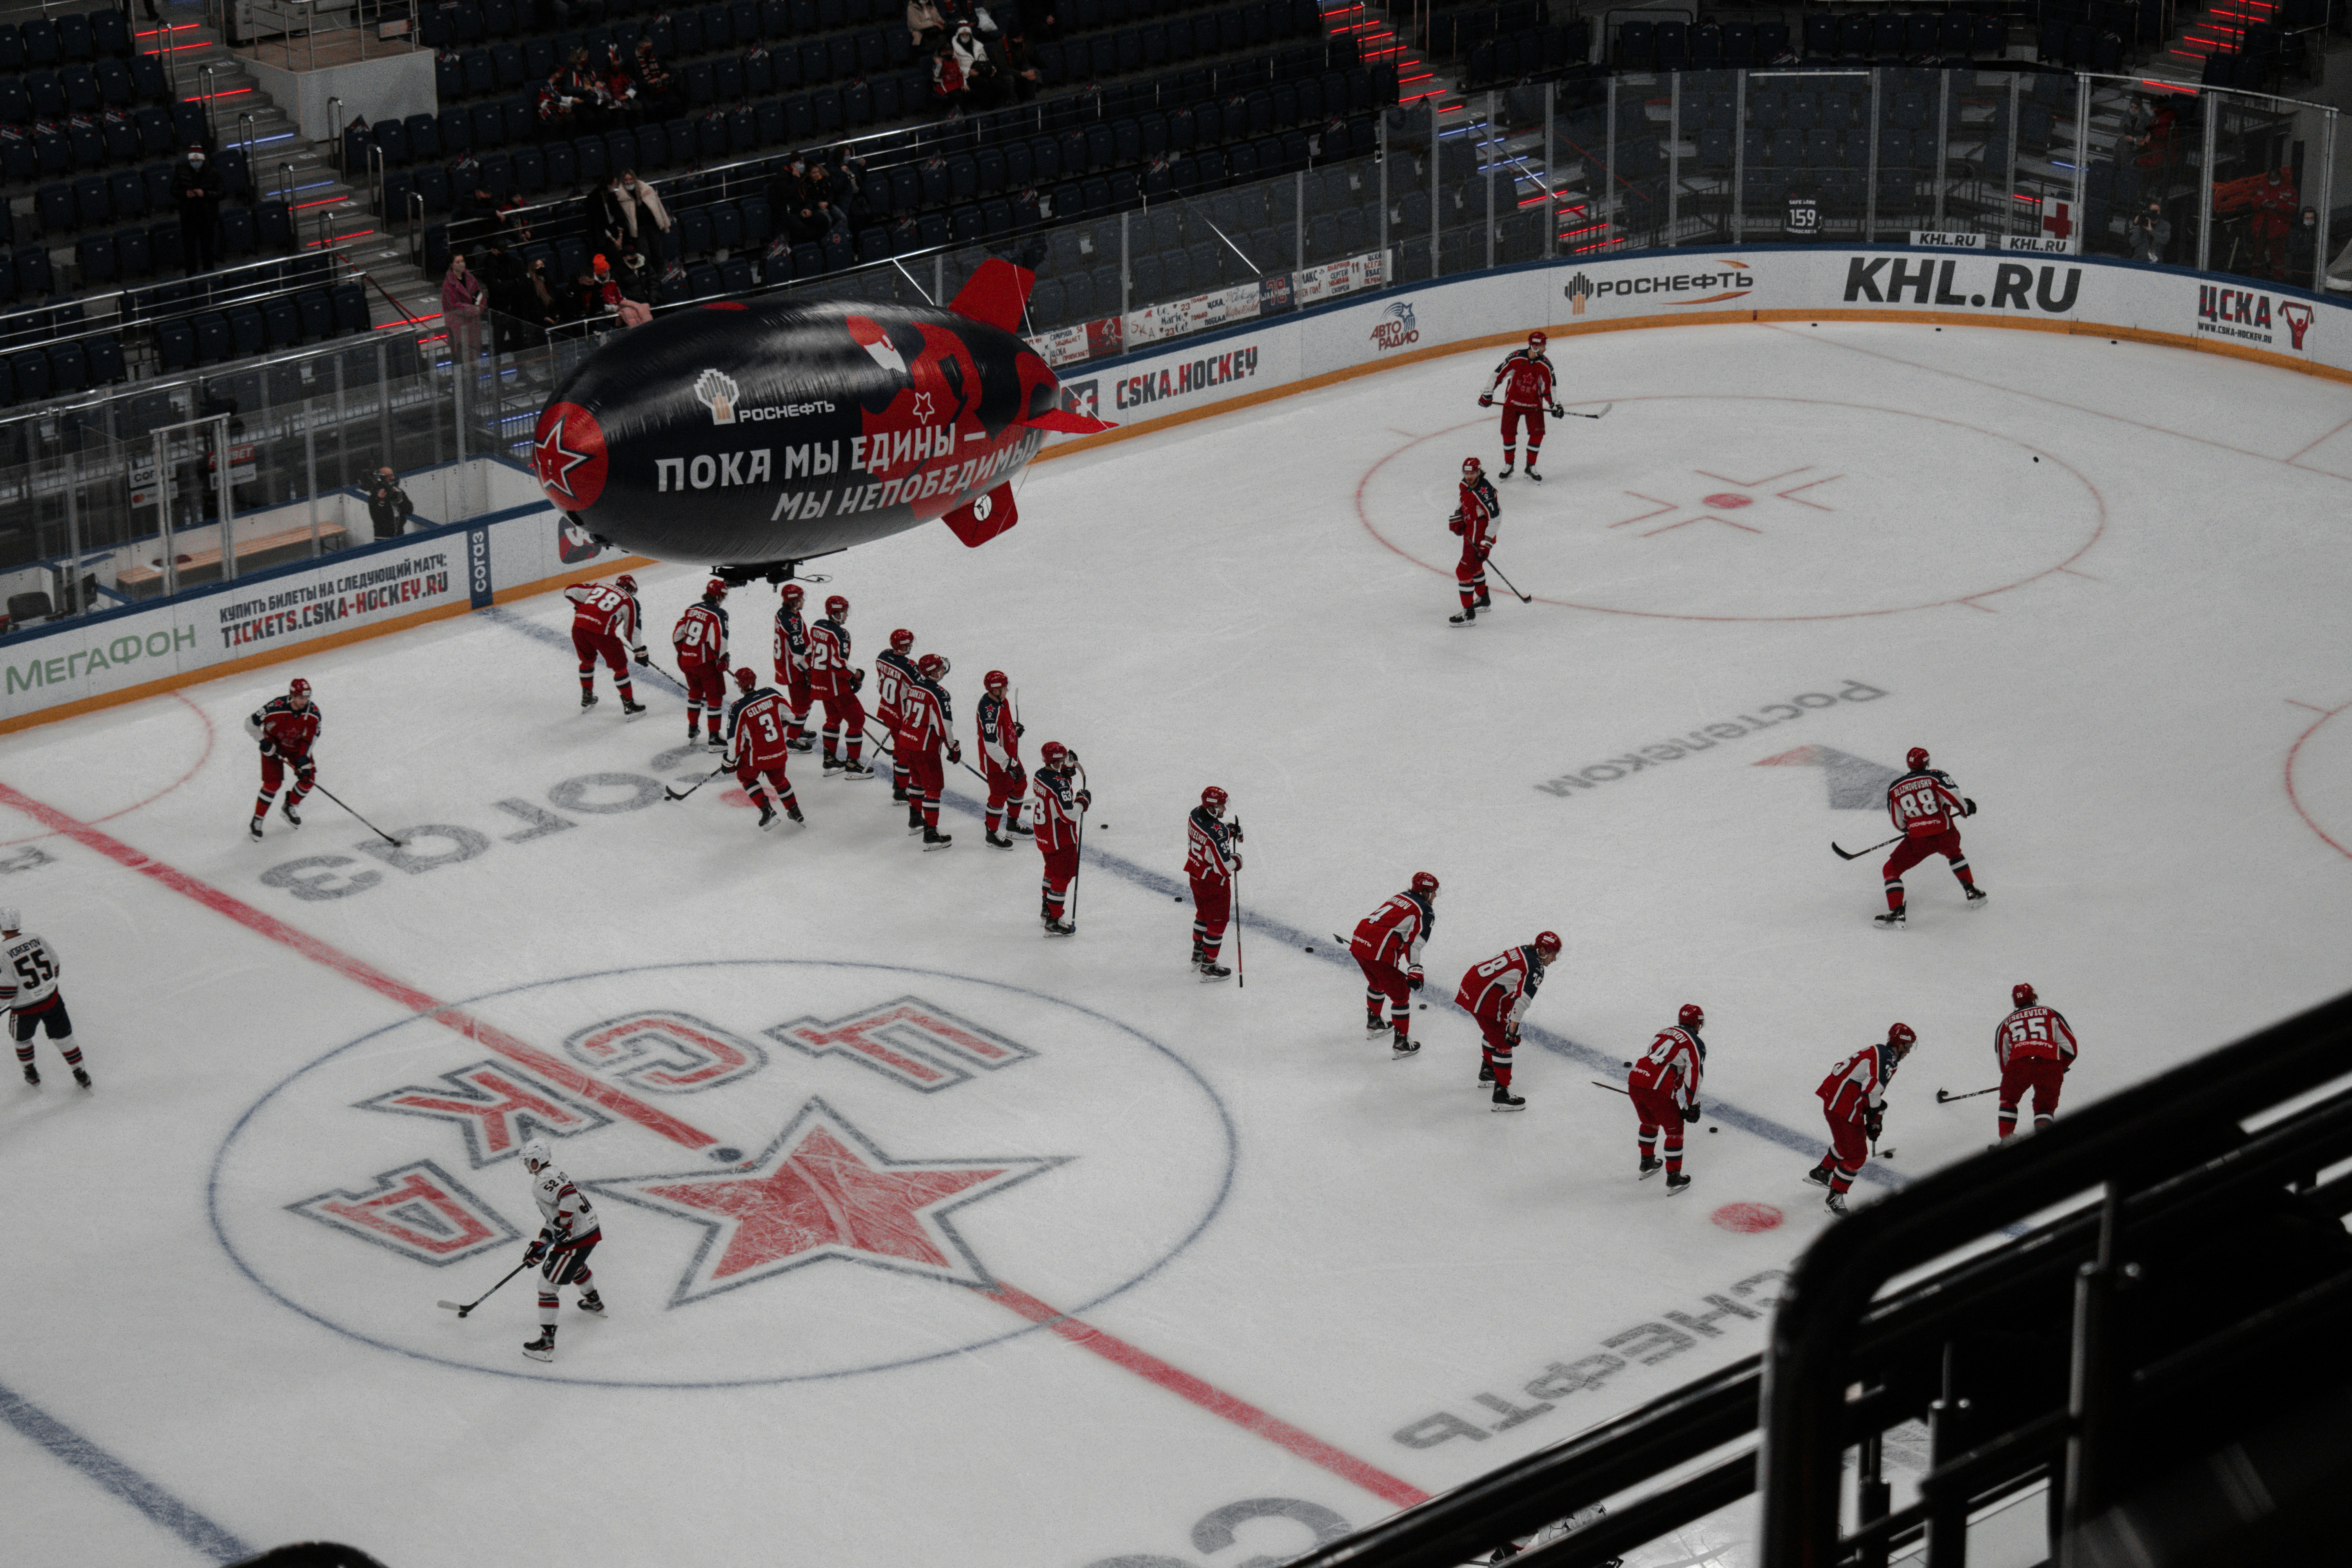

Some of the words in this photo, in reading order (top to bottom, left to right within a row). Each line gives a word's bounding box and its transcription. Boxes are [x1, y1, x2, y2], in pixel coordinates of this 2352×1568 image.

[1789, 209, 1816, 227] 159
[1919, 232, 1976, 247] KHL.RU
[2009, 237, 2066, 253] KHL.RU
[1597, 272, 1753, 298] РОСНЕФТЬ
[1844, 257, 2082, 313] KHL.RU
[1180, 302, 1191, 311] 23
[2198, 284, 2272, 330] ЦСКА
[1164, 327, 1175, 337] 23
[1369, 319, 1401, 340] АВТО
[1378, 329, 1419, 351] РАДИО
[2198, 321, 2272, 344] WWW.CSKA-HOCKEY.RU
[1116, 346, 1258, 410] CSKA.HOCKEY
[739, 399, 836, 423] РОСНЕФТЬ
[655, 448, 771, 492] ПОКА
[785, 439, 839, 480] МЫ
[851, 422, 956, 474] ЕДИНЫ
[770, 489, 833, 522] МЫ
[1487, 501, 1495, 512] 7
[219, 599, 266, 624] КУПИТЬ
[269, 585, 317, 612] БИЛЕТЫ
[319, 581, 334, 599] НА
[336, 559, 412, 594] СЛЕДУЮЩИЙ
[413, 552, 448, 575] МАТЧ:
[584, 586, 622, 612] 28
[221, 570, 448, 649] TICKETS.CSKA-HOCKEY.RU
[792, 634, 805, 646] 23
[746, 699, 774, 718] GILMOUR
[758, 712, 779, 743] 3
[985, 723, 996, 734] 87
[1533, 679, 1890, 797] Ростелеком
[1061, 790, 1072, 802] 63
[1893, 779, 1933, 797] BLAZHIYEVSKY
[1899, 788, 1940, 818] 88
[1220, 840, 1230, 854] 35
[1368, 904, 1394, 925] 4
[6, 937, 41, 959] VOROBYOV
[13, 947, 53, 990] 55
[2004, 1008, 2048, 1028] KISELEVICH
[2008, 1016, 2048, 1043] 55
[284, 995, 1040, 1268] ЦСКА
[543, 1179, 559, 1192] 52
